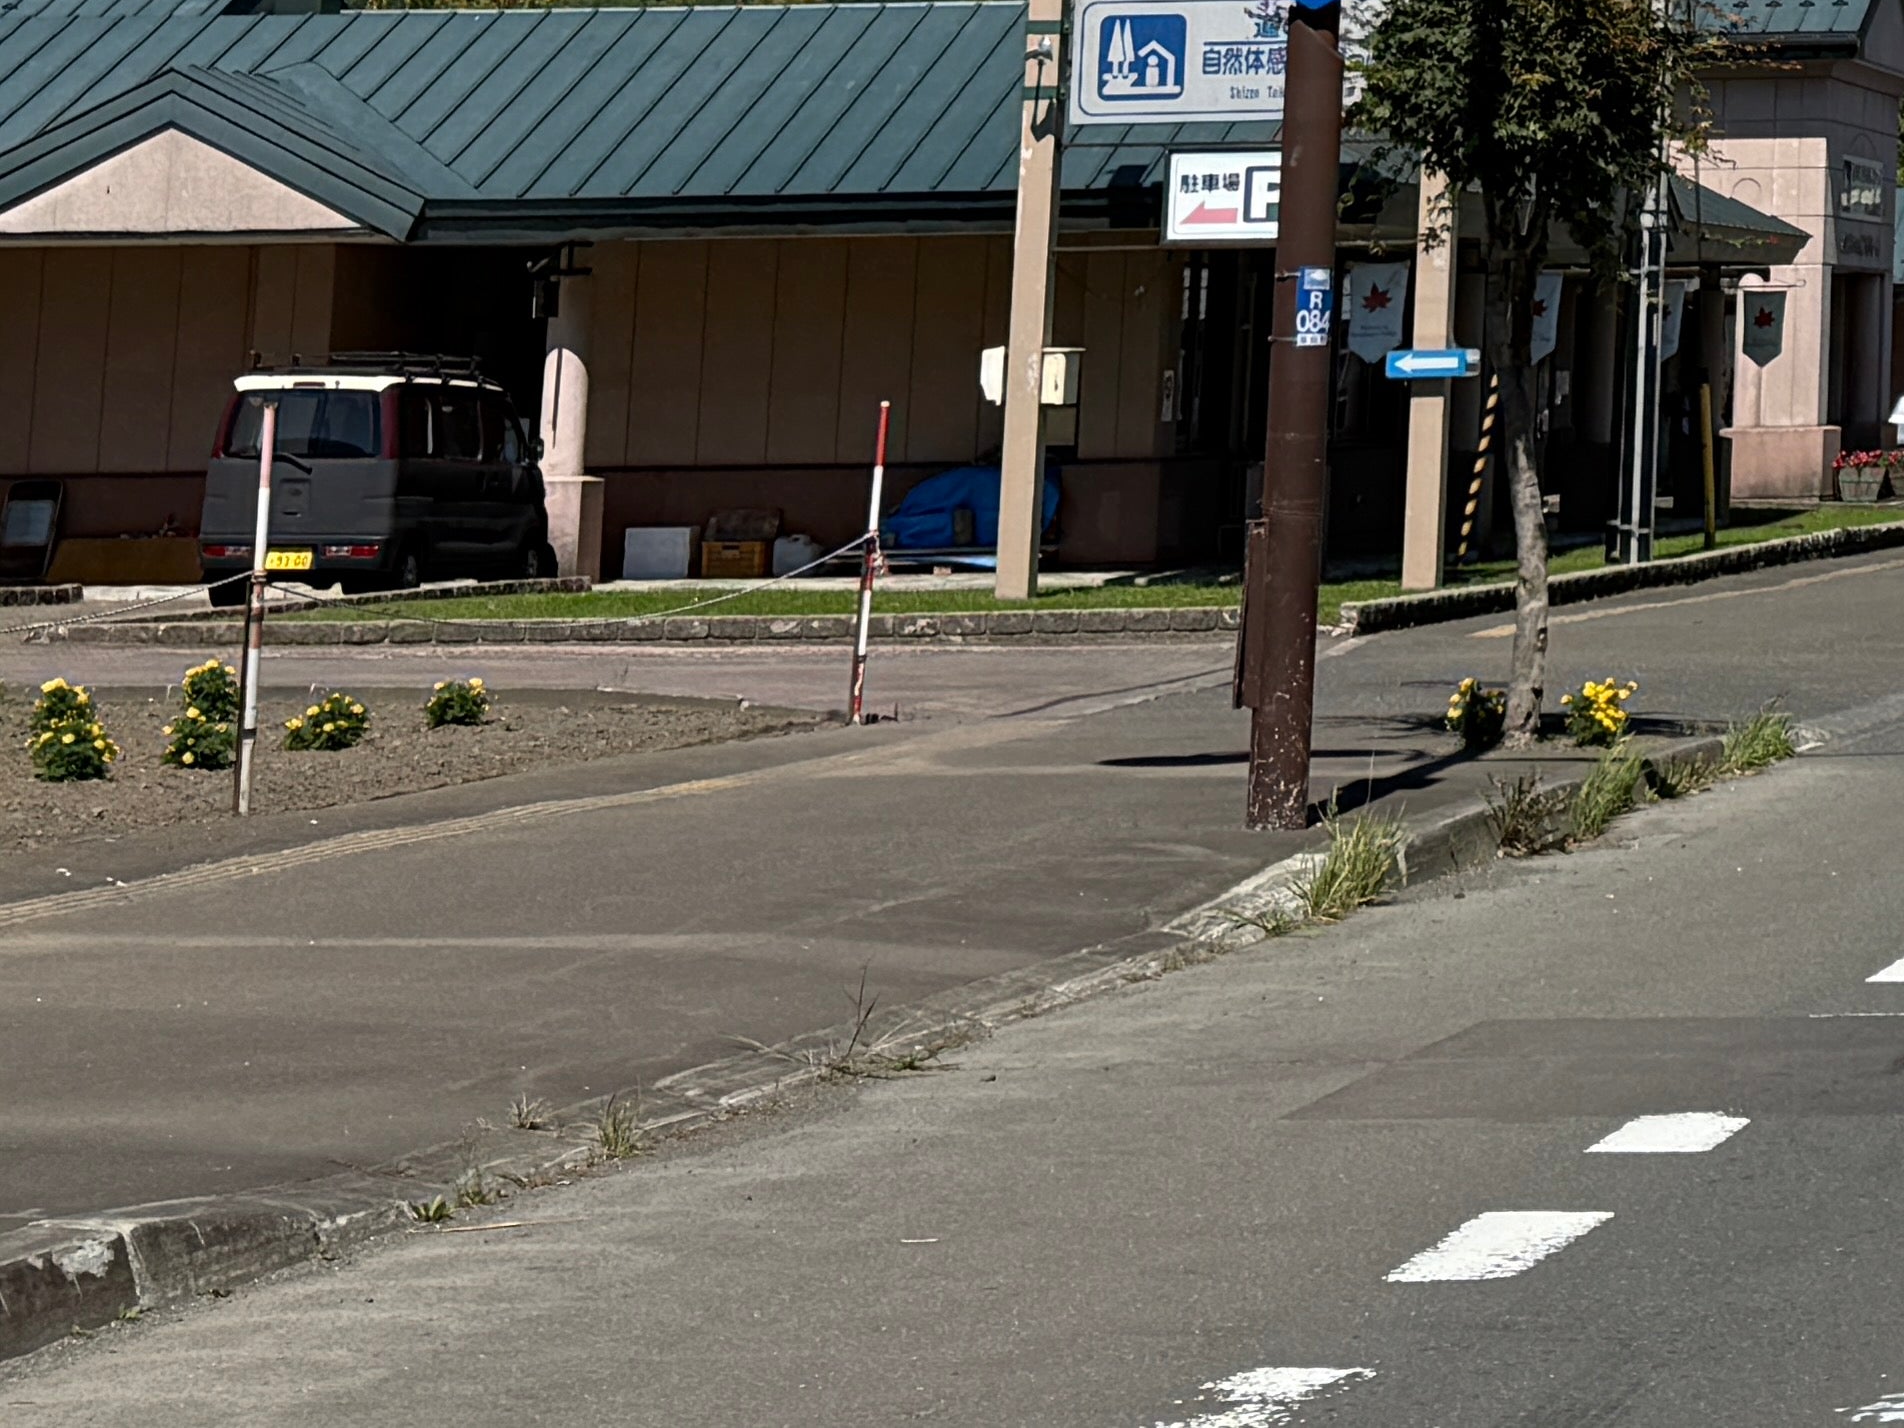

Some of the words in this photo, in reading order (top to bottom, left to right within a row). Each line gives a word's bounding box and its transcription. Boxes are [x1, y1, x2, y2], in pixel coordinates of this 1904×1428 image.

[1180, 173, 1240, 194] 駐車場
[1310, 291, 1323, 309] R
[1296, 310, 1330, 334] 084
